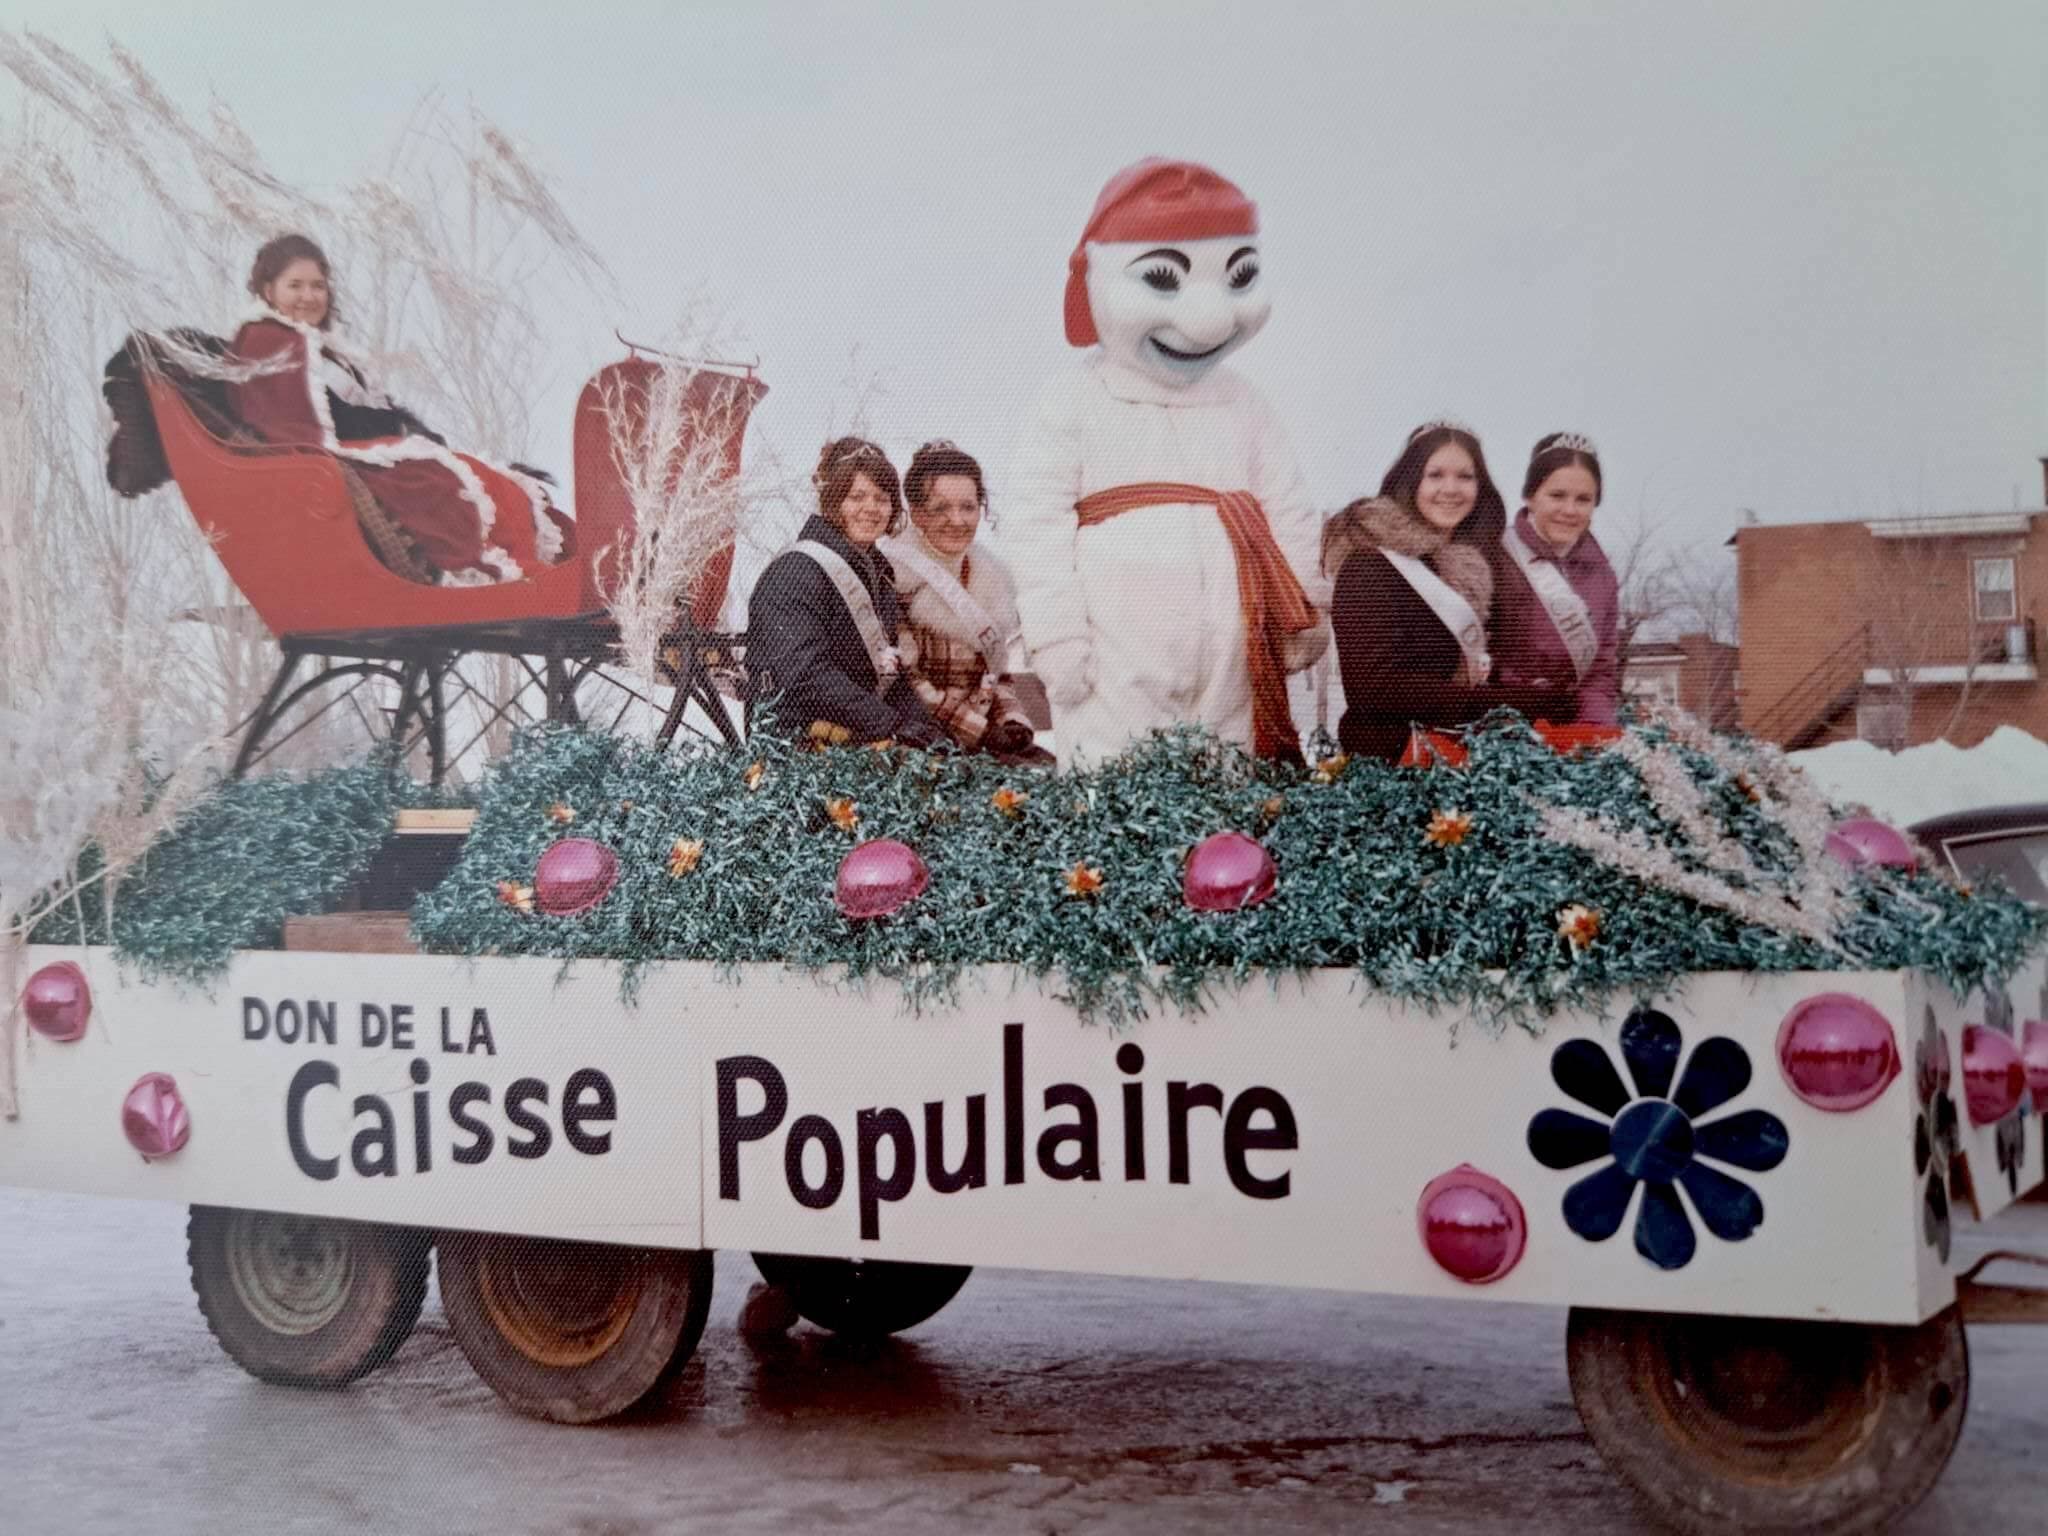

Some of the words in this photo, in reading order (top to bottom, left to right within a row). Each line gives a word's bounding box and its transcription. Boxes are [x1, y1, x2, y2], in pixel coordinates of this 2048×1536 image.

[242, 997, 337, 1045] DON
[360, 1003, 415, 1050] DE
[440, 1006, 497, 1056] LA
[285, 1057, 618, 1181] Caisse
[715, 1022, 1300, 1241] Populaire
